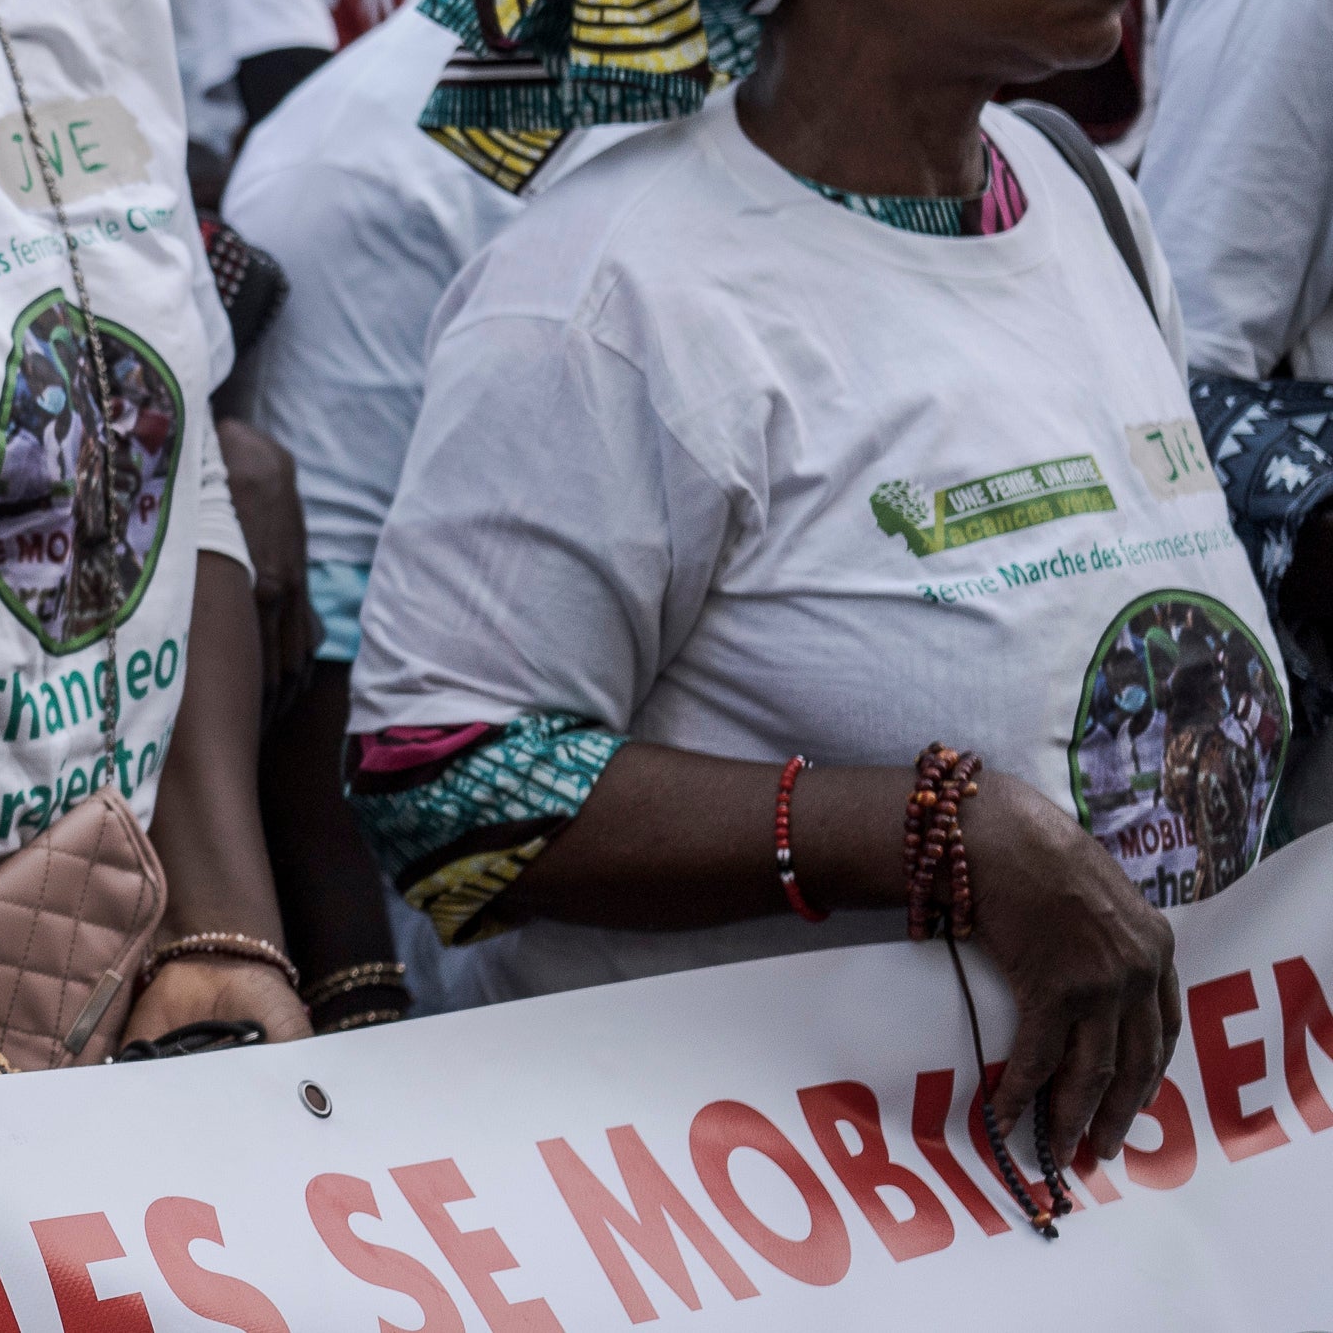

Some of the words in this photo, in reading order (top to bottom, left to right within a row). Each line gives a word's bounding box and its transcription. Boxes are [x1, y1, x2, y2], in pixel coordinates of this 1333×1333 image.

[948, 483, 989, 512] UNE
[1039, 465, 1062, 486] UN
[997, 546, 1086, 589] Marche
[1091, 541, 1123, 571] des
[304, 1157, 568, 1333] SE
